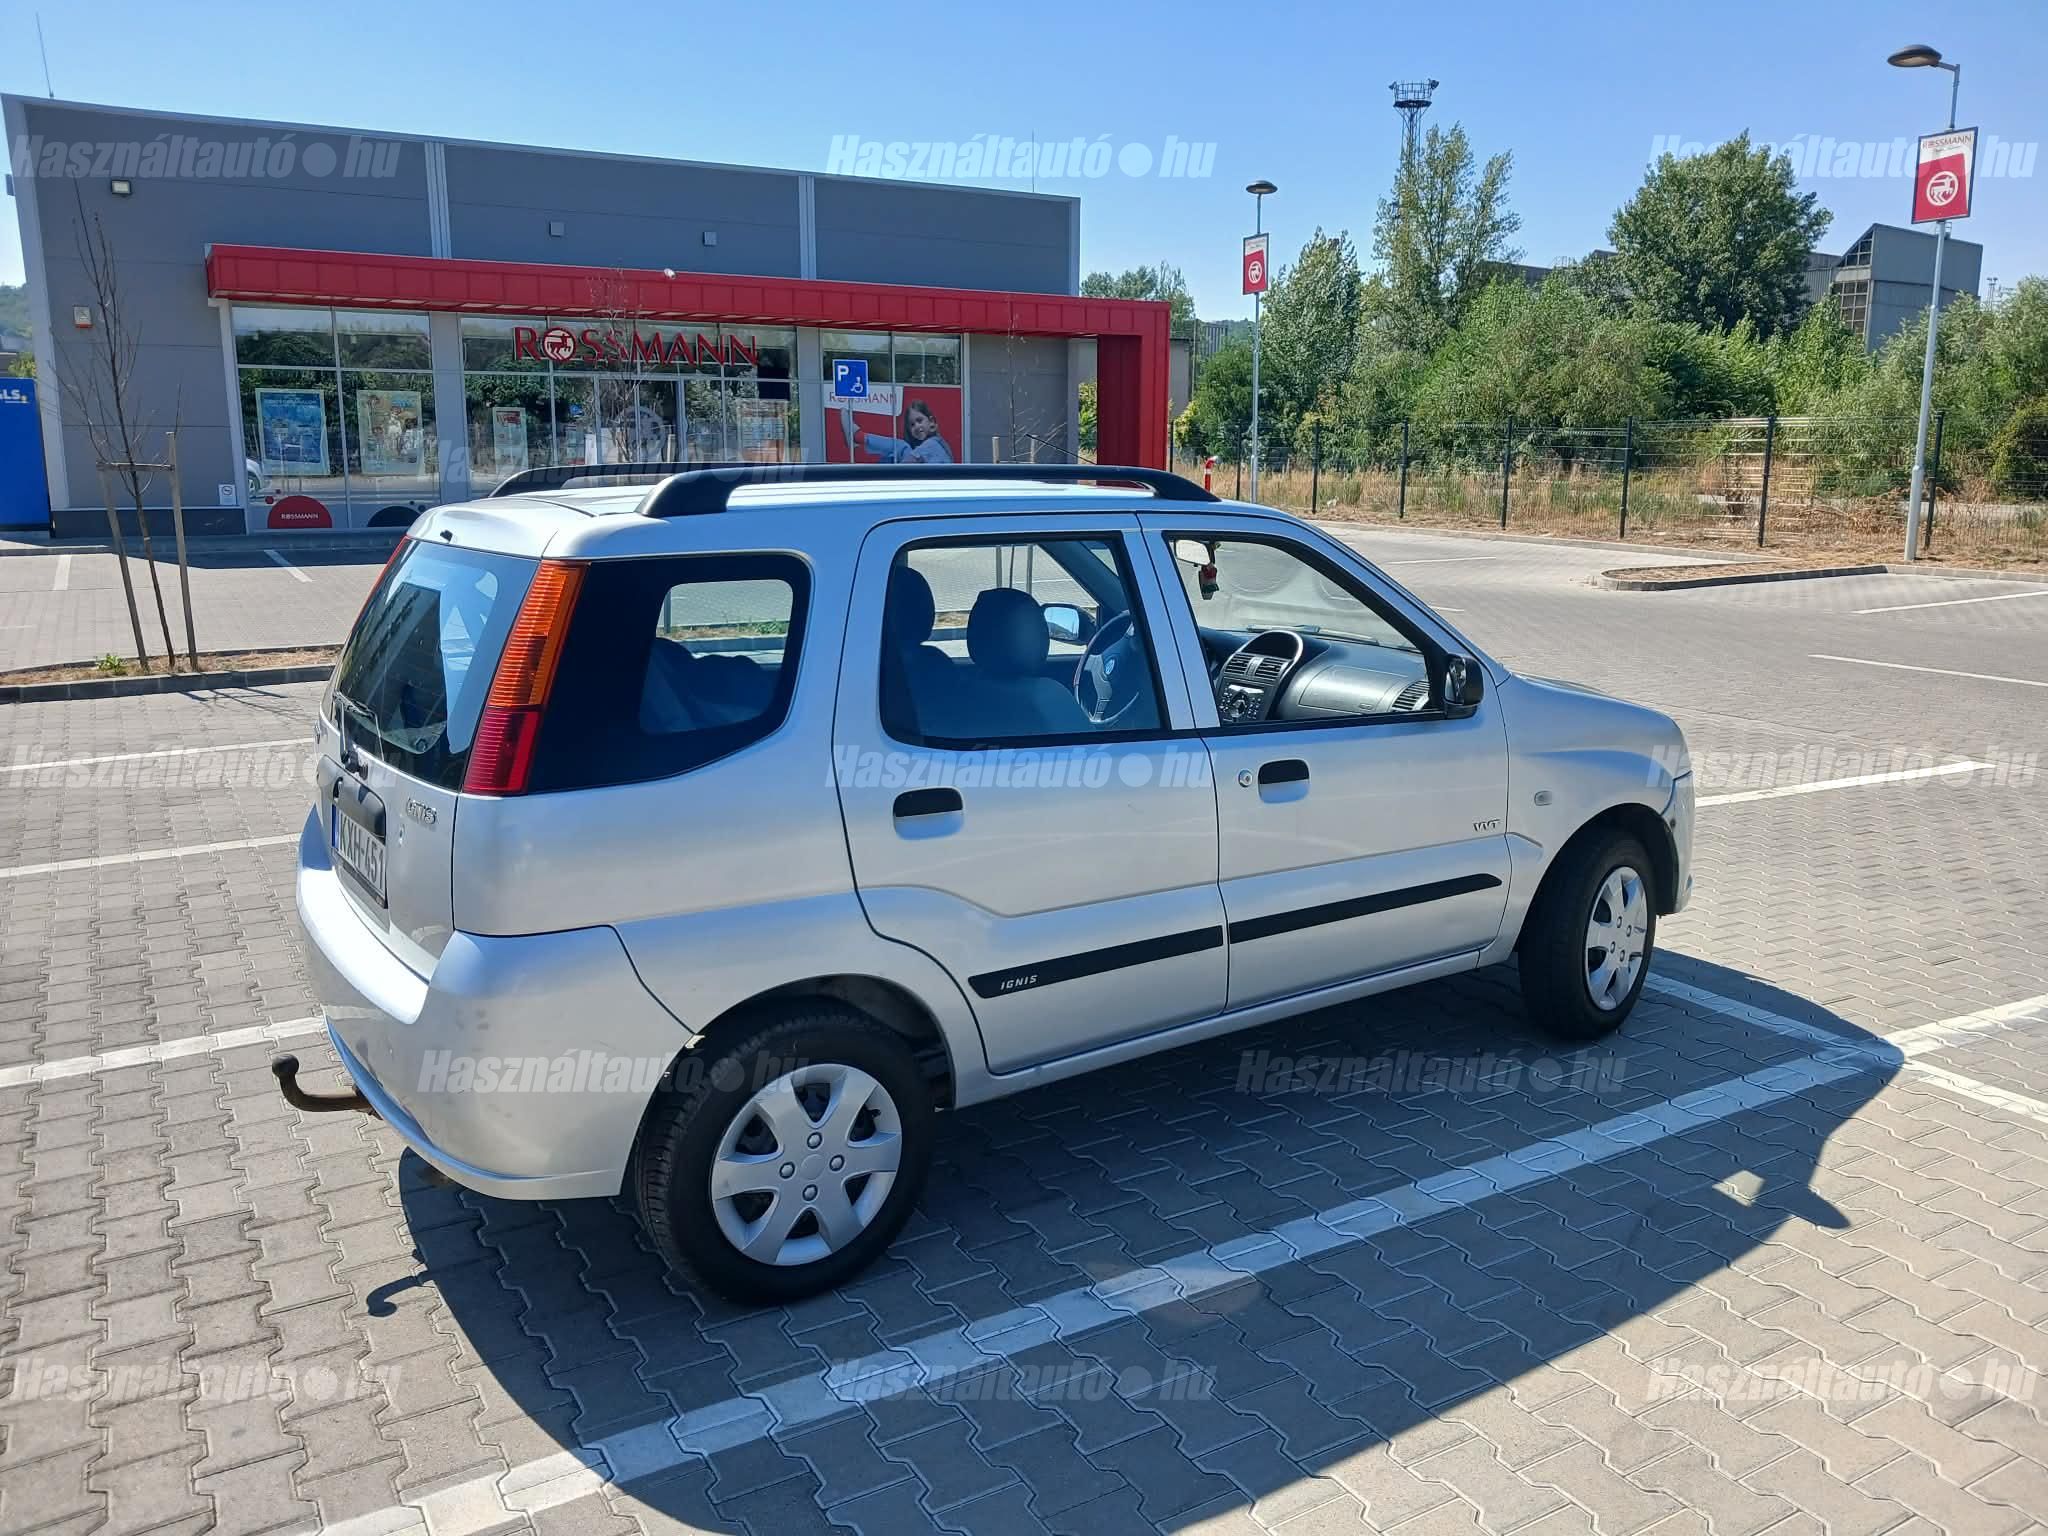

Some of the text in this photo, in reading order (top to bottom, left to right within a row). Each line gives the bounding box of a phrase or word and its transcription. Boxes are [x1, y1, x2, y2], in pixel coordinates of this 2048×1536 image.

[513, 326, 759, 368] ROSSMANN
[837, 365, 849, 381] P
[1000, 974, 1039, 991] IGNIS
